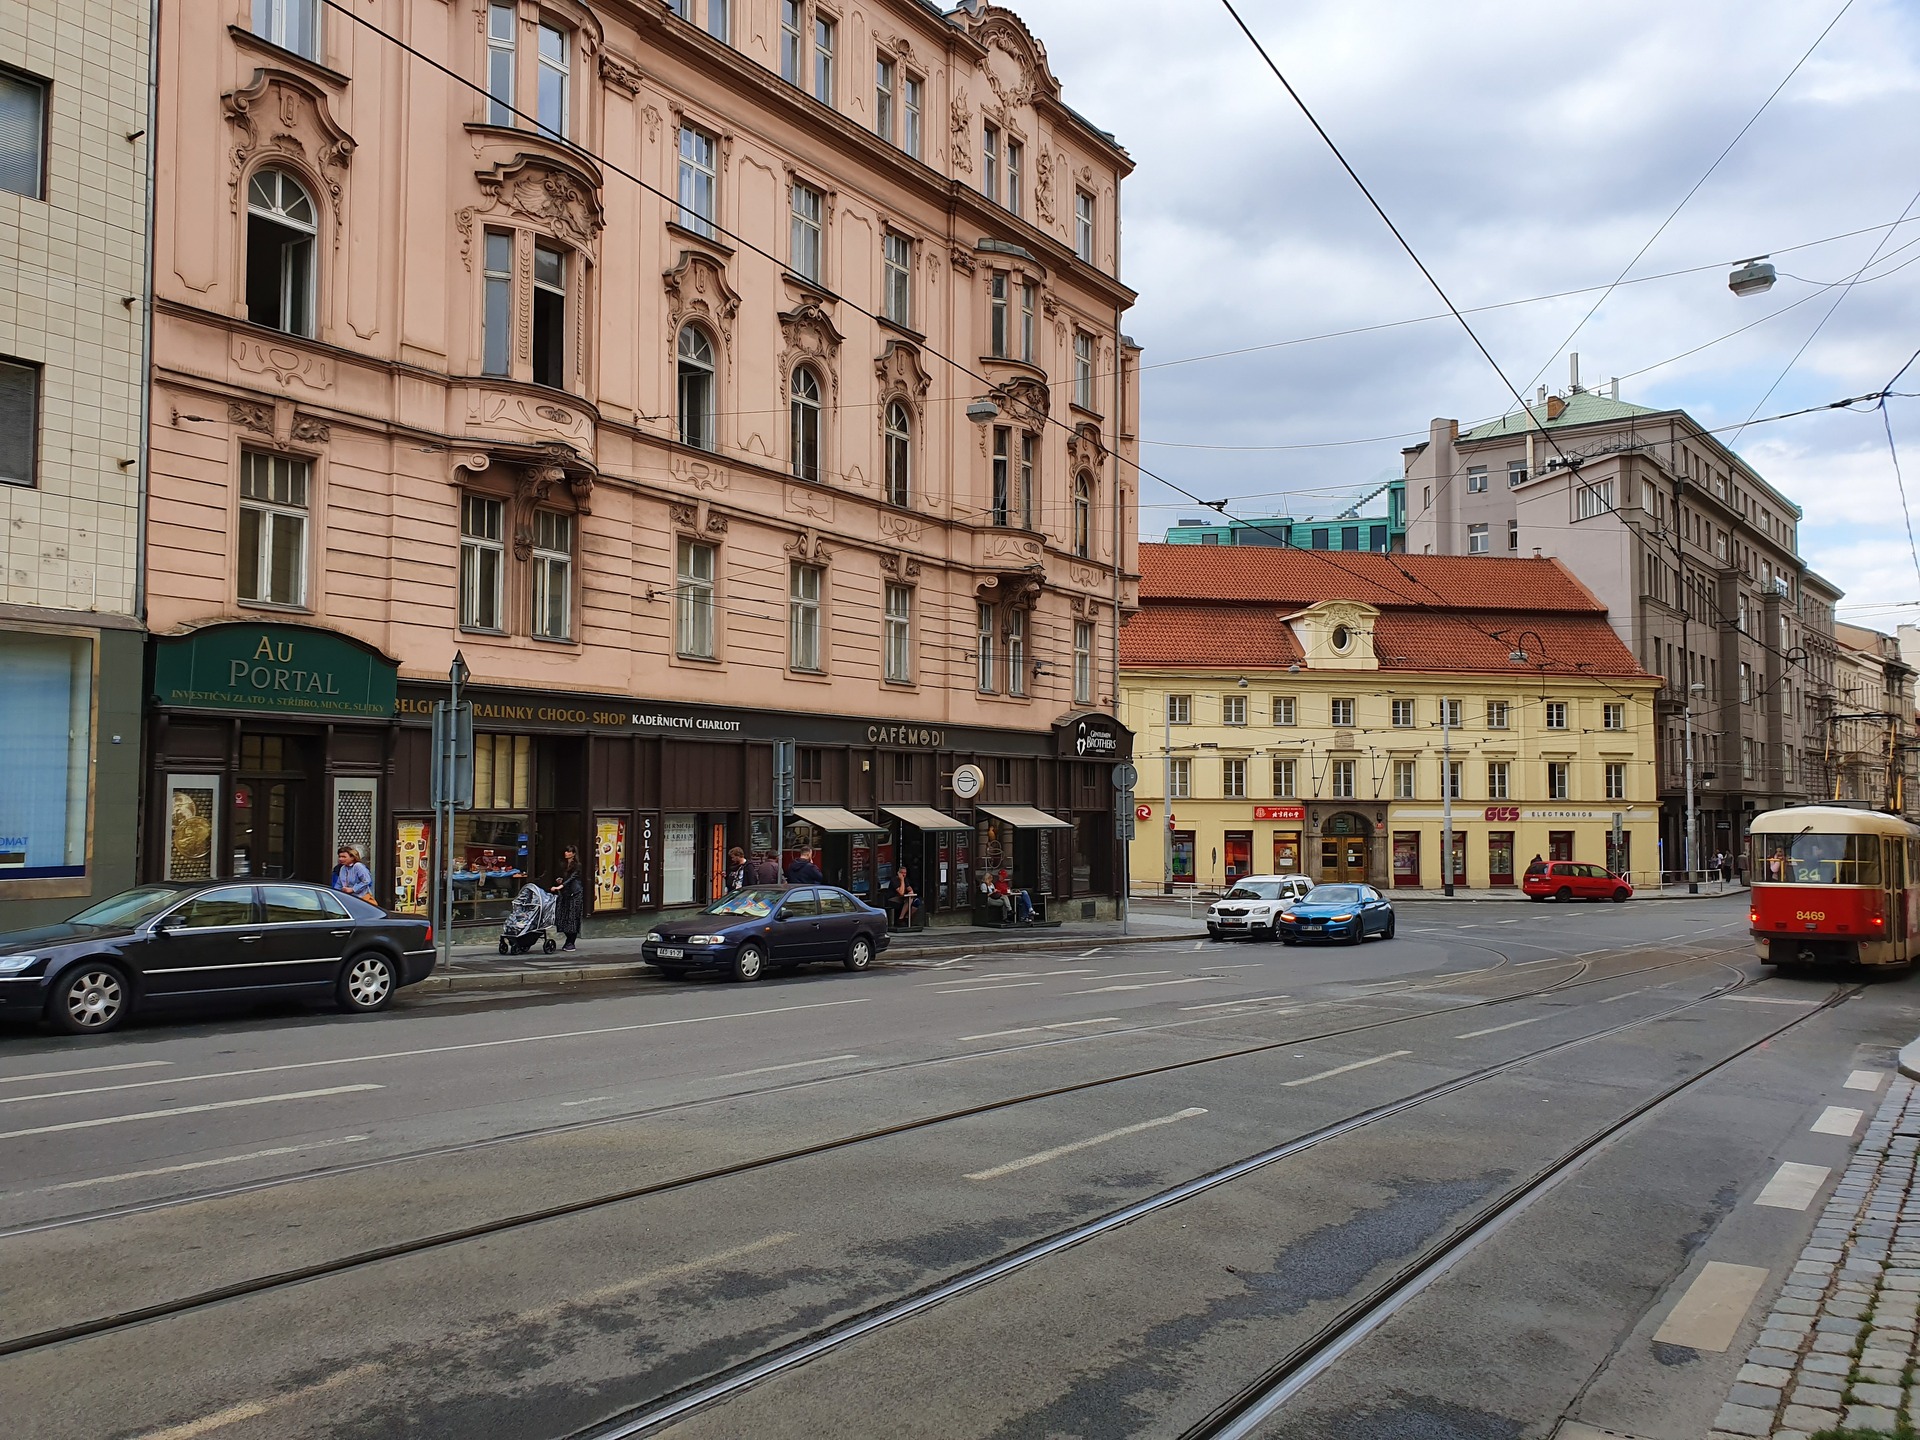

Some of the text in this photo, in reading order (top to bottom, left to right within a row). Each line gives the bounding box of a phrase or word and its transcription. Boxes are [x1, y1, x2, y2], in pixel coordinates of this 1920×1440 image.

[228, 659, 340, 695] PORTAL
[171, 689, 230, 702] INVESTIČNÍ
[232, 693, 265, 704] ZLATO
[267, 697, 275, 705] A
[473, 702, 534, 720] RALINKY
[593, 711, 626, 726] SHOP
[632, 713, 741, 732] KADEŘNICTVÍ CHARLOTT
[1086, 735, 1117, 749] BROTHERS
[1484, 806, 1520, 822] GES
[642, 819, 652, 903] SOLÁRIUM
[1799, 868, 1821, 881] 24
[1796, 910, 1825, 921] 8469
